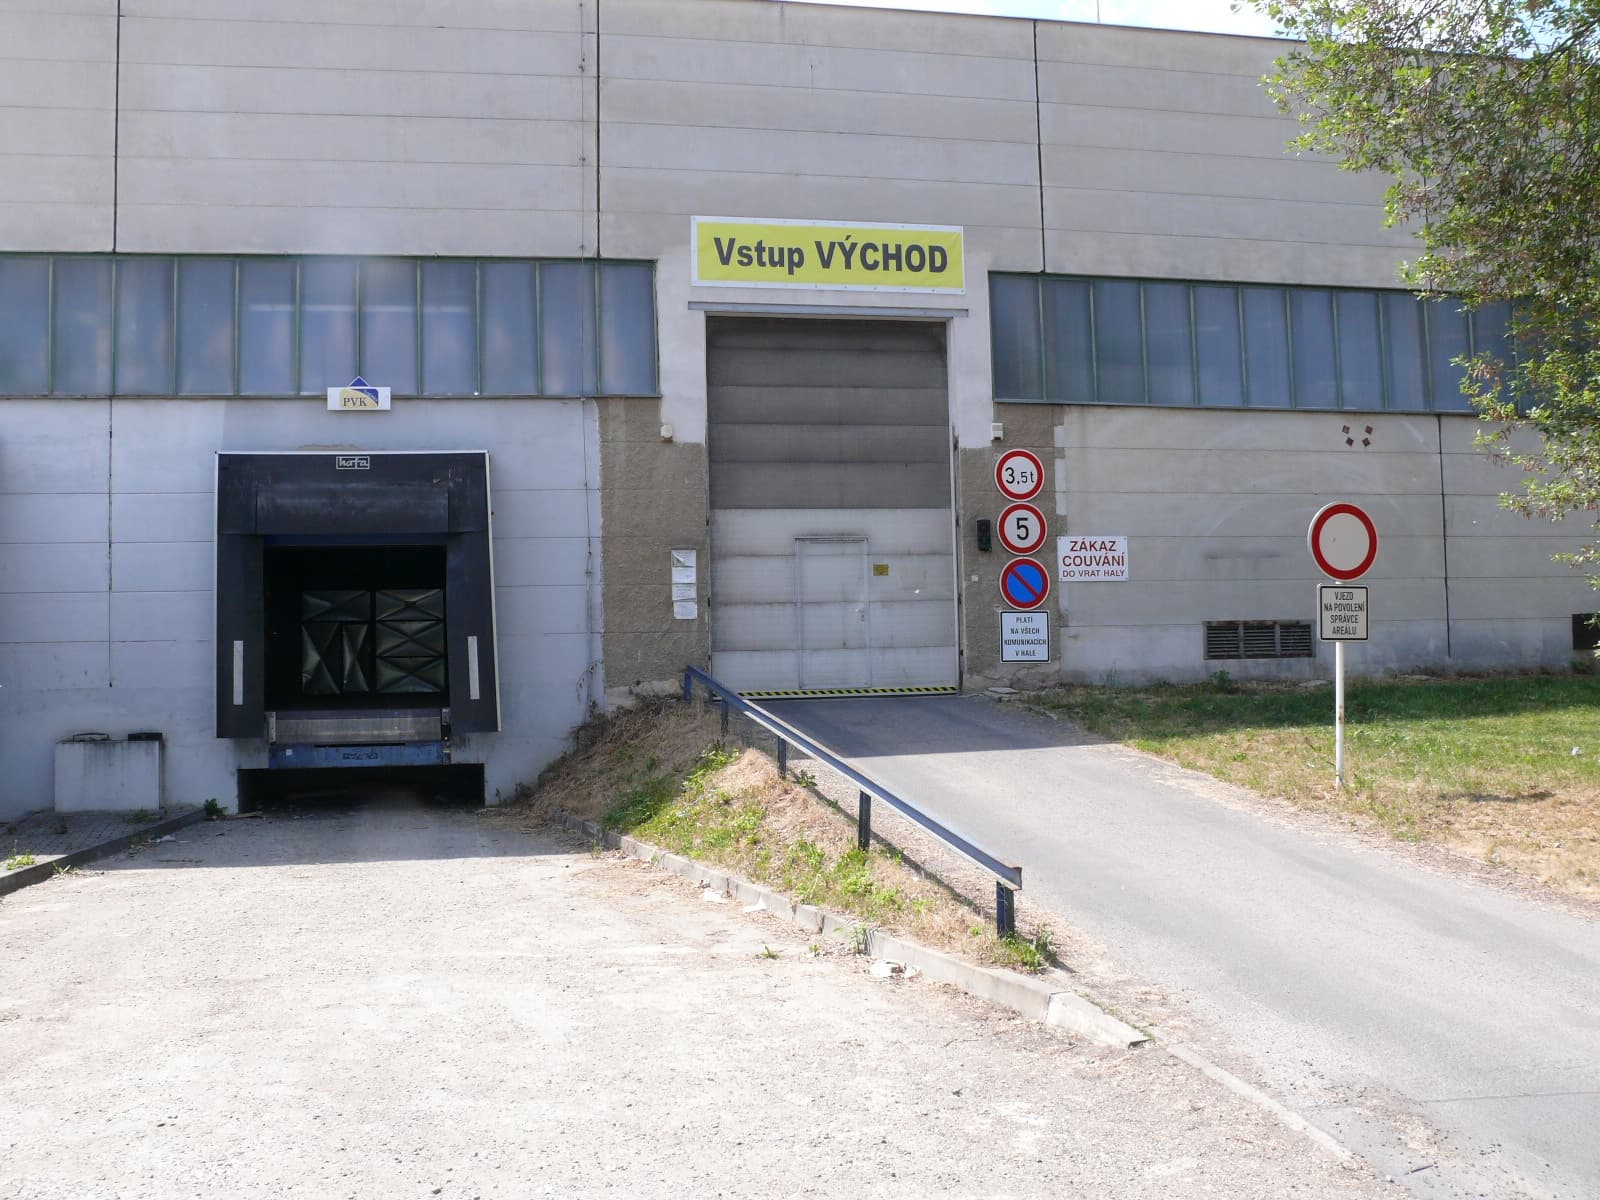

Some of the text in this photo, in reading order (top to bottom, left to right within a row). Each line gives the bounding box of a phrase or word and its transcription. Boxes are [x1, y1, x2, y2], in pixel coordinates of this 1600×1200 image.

[713, 235, 948, 275] Vstup VÝCHOD
[343, 397, 368, 407] PVK
[1016, 517, 1029, 541] 5
[1069, 537, 1117, 552] ZÁKAZ
[1062, 552, 1125, 567] COUVÁNÍ
[1062, 569, 1125, 578] DO VRAT HALY
[1334, 591, 1354, 601] VJEZD
[1323, 600, 1365, 612] NA POVOLENÍ
[1015, 615, 1033, 624] PLATÍ
[1330, 613, 1359, 624] SPRÁVCE
[1010, 625, 1040, 635] NA VŠECH
[1332, 625, 1357, 635] AREÁLU
[1015, 649, 1037, 657] V HALE
